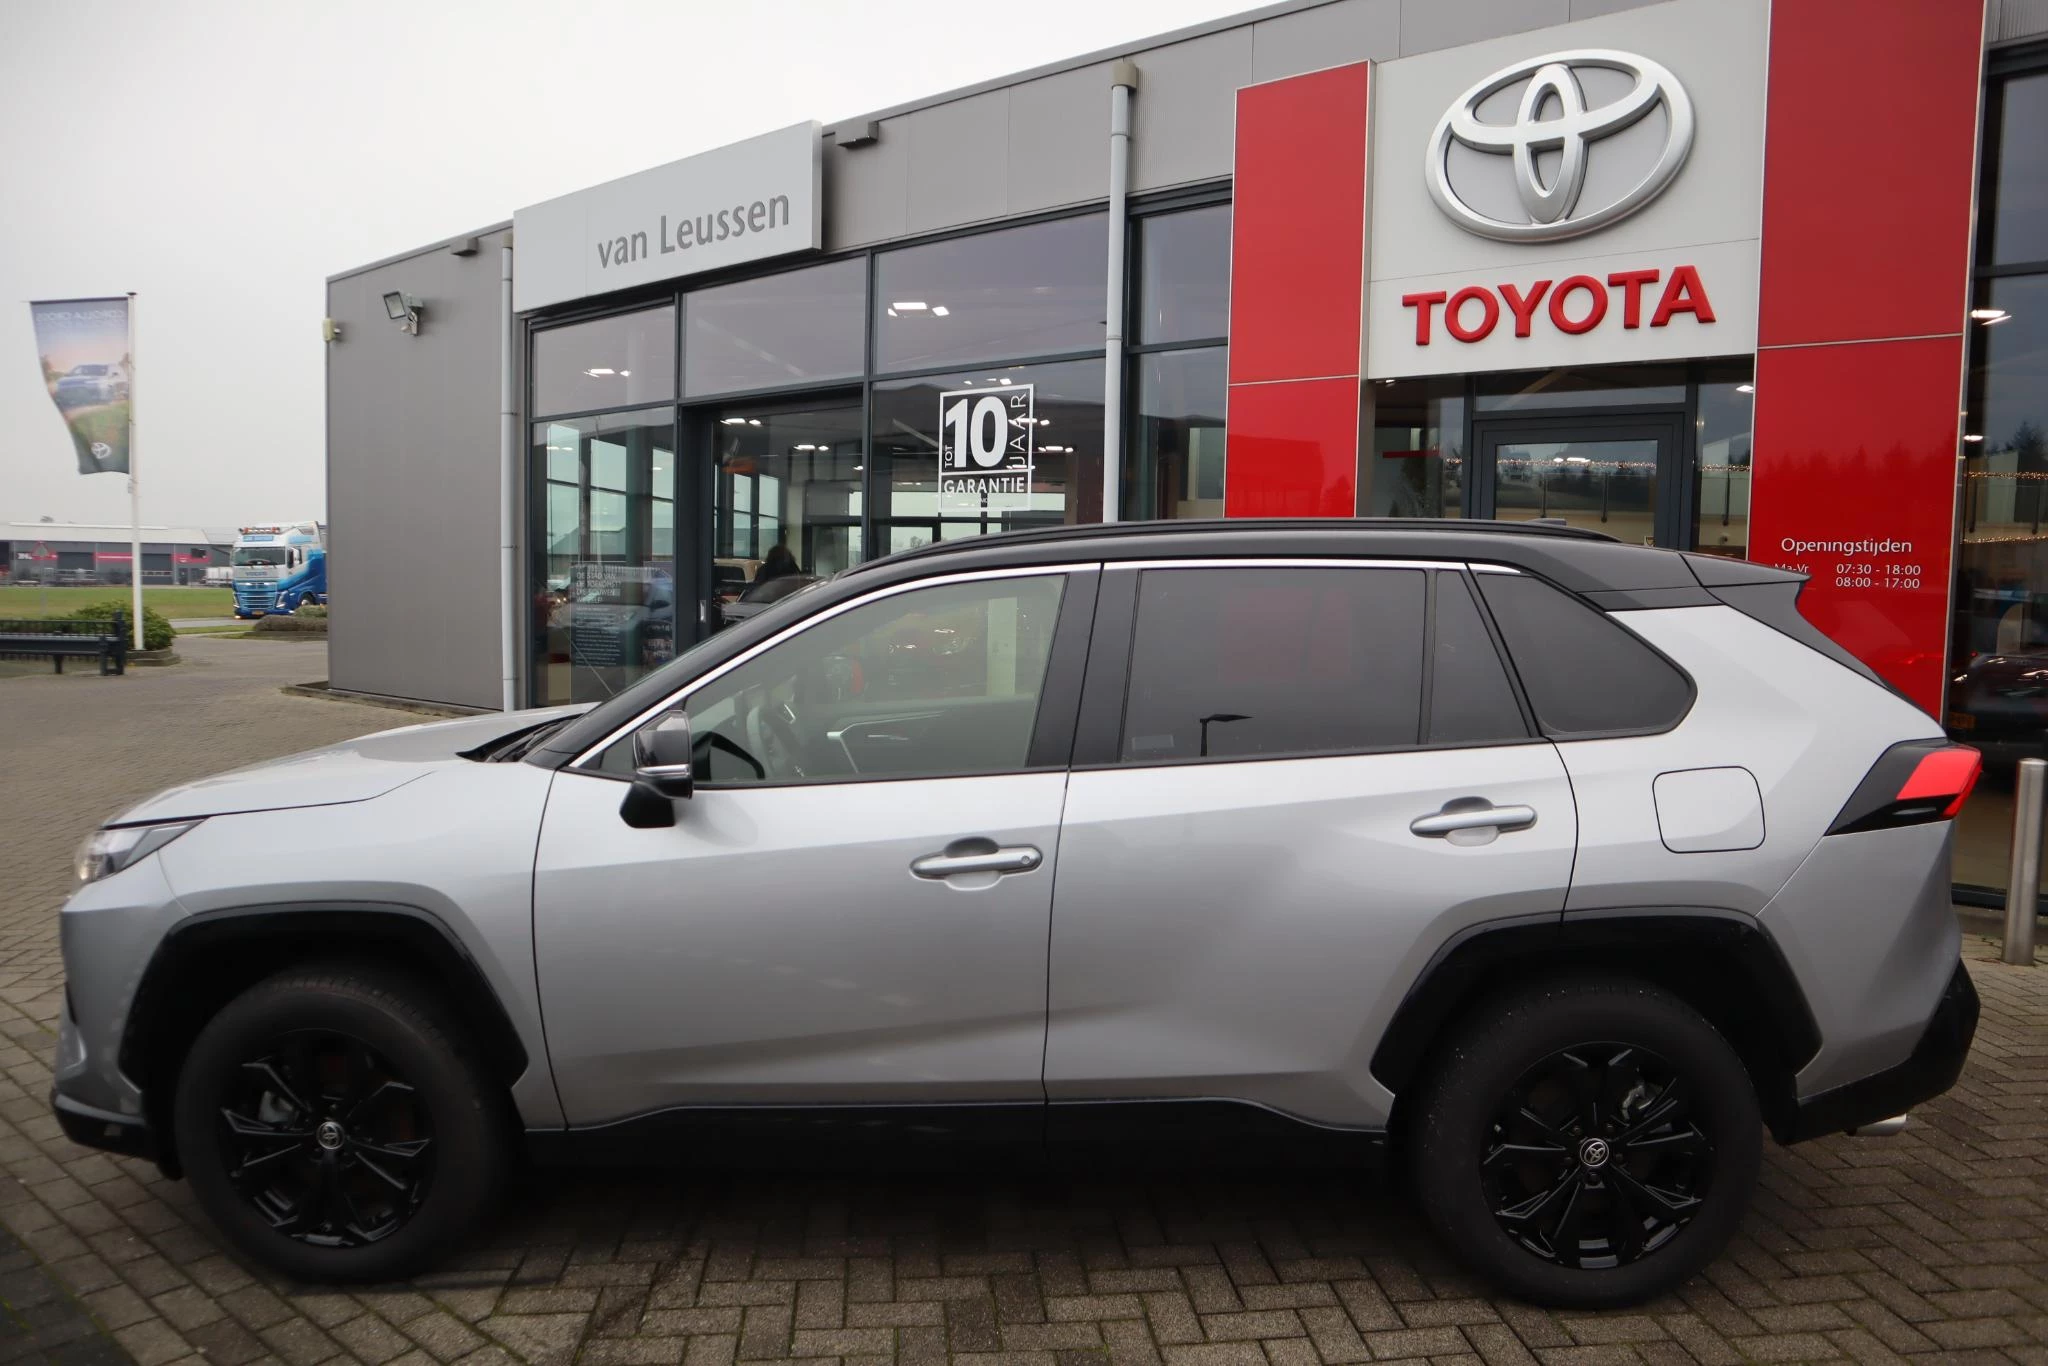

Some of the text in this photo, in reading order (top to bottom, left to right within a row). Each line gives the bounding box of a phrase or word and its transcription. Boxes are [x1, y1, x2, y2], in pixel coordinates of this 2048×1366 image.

[598, 193, 790, 269] van Leussen
[1402, 265, 1716, 346] TOYOTA
[945, 396, 1008, 468] 10
[1009, 394, 1026, 467] JAAR
[944, 445, 953, 469] TOT
[944, 477, 1025, 494] GARANTIE
[1781, 537, 1912, 556] Openingstijden
[1836, 563, 1872, 574] 07:30
[1885, 564, 1921, 575] 18:00
[1836, 577, 1871, 587] 08:00
[1884, 578, 1920, 589] 17:00
